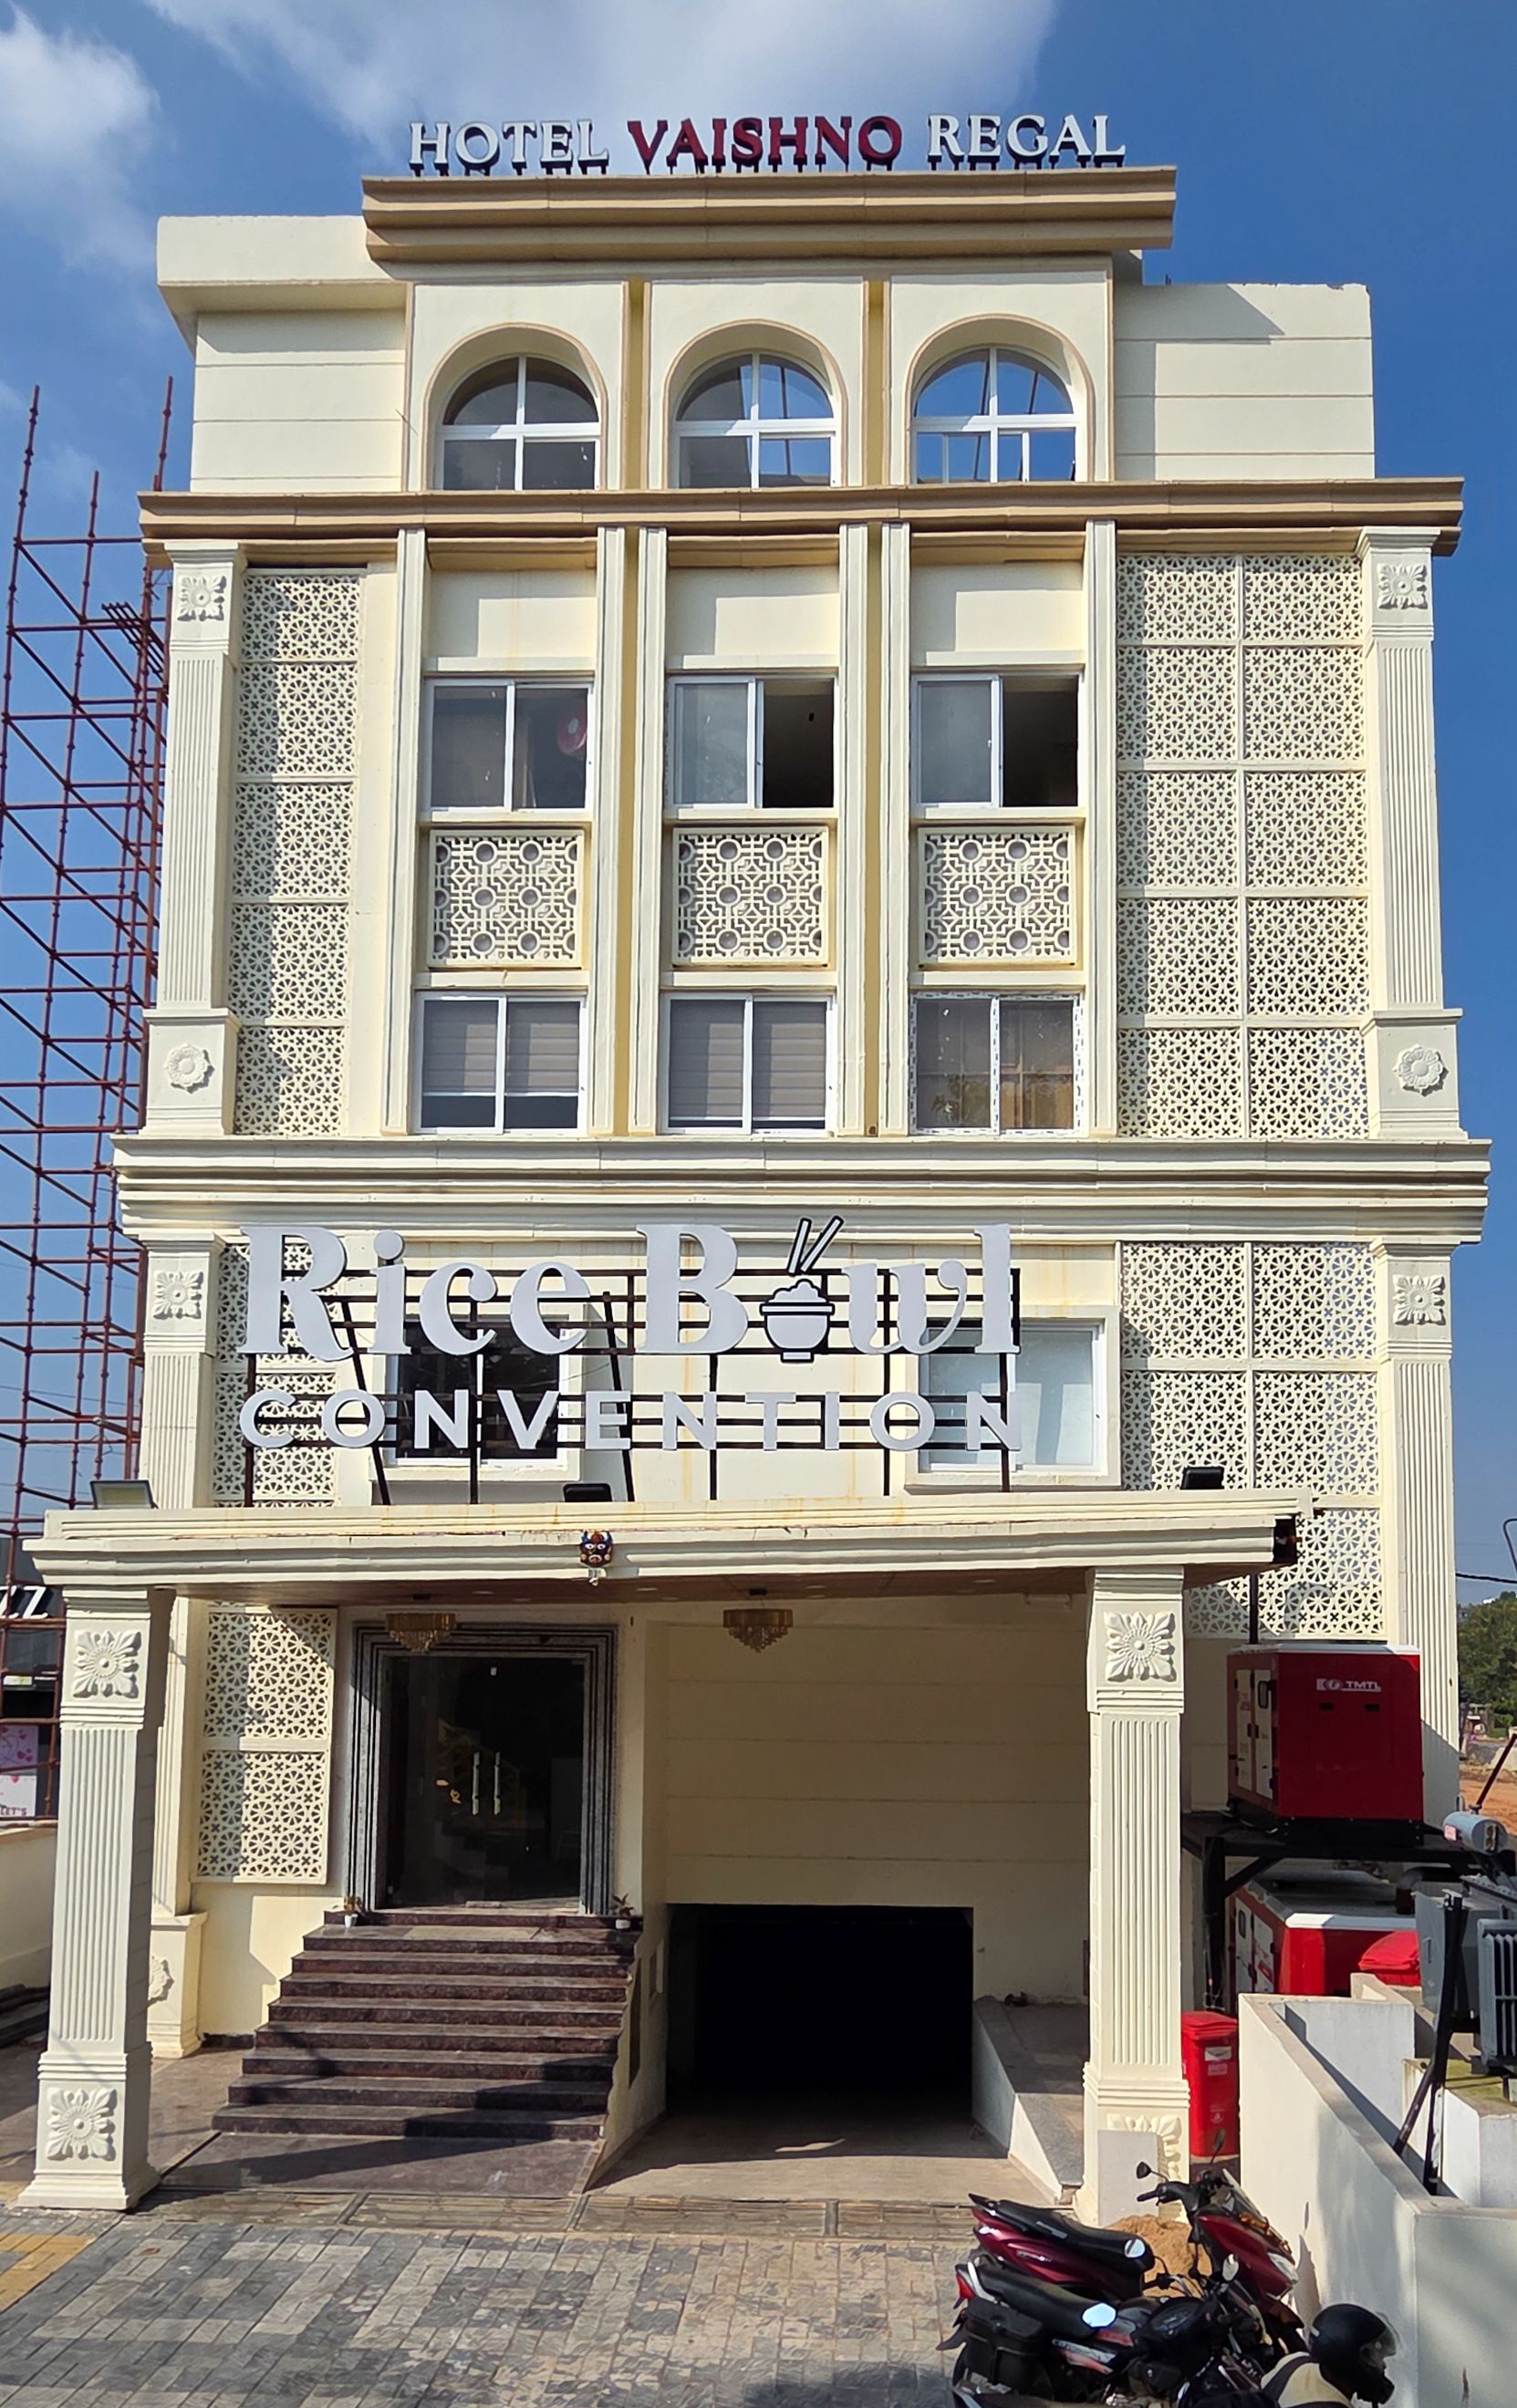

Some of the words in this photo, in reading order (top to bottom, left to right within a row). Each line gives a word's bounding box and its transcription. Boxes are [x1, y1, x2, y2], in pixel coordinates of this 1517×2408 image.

[410, 119, 609, 167] HOTEL
[628, 116, 903, 167] VAISHNO
[928, 114, 1126, 161] REGAL
[240, 1224, 591, 1361] Rice
[239, 1389, 1023, 1450] CONVENTION
